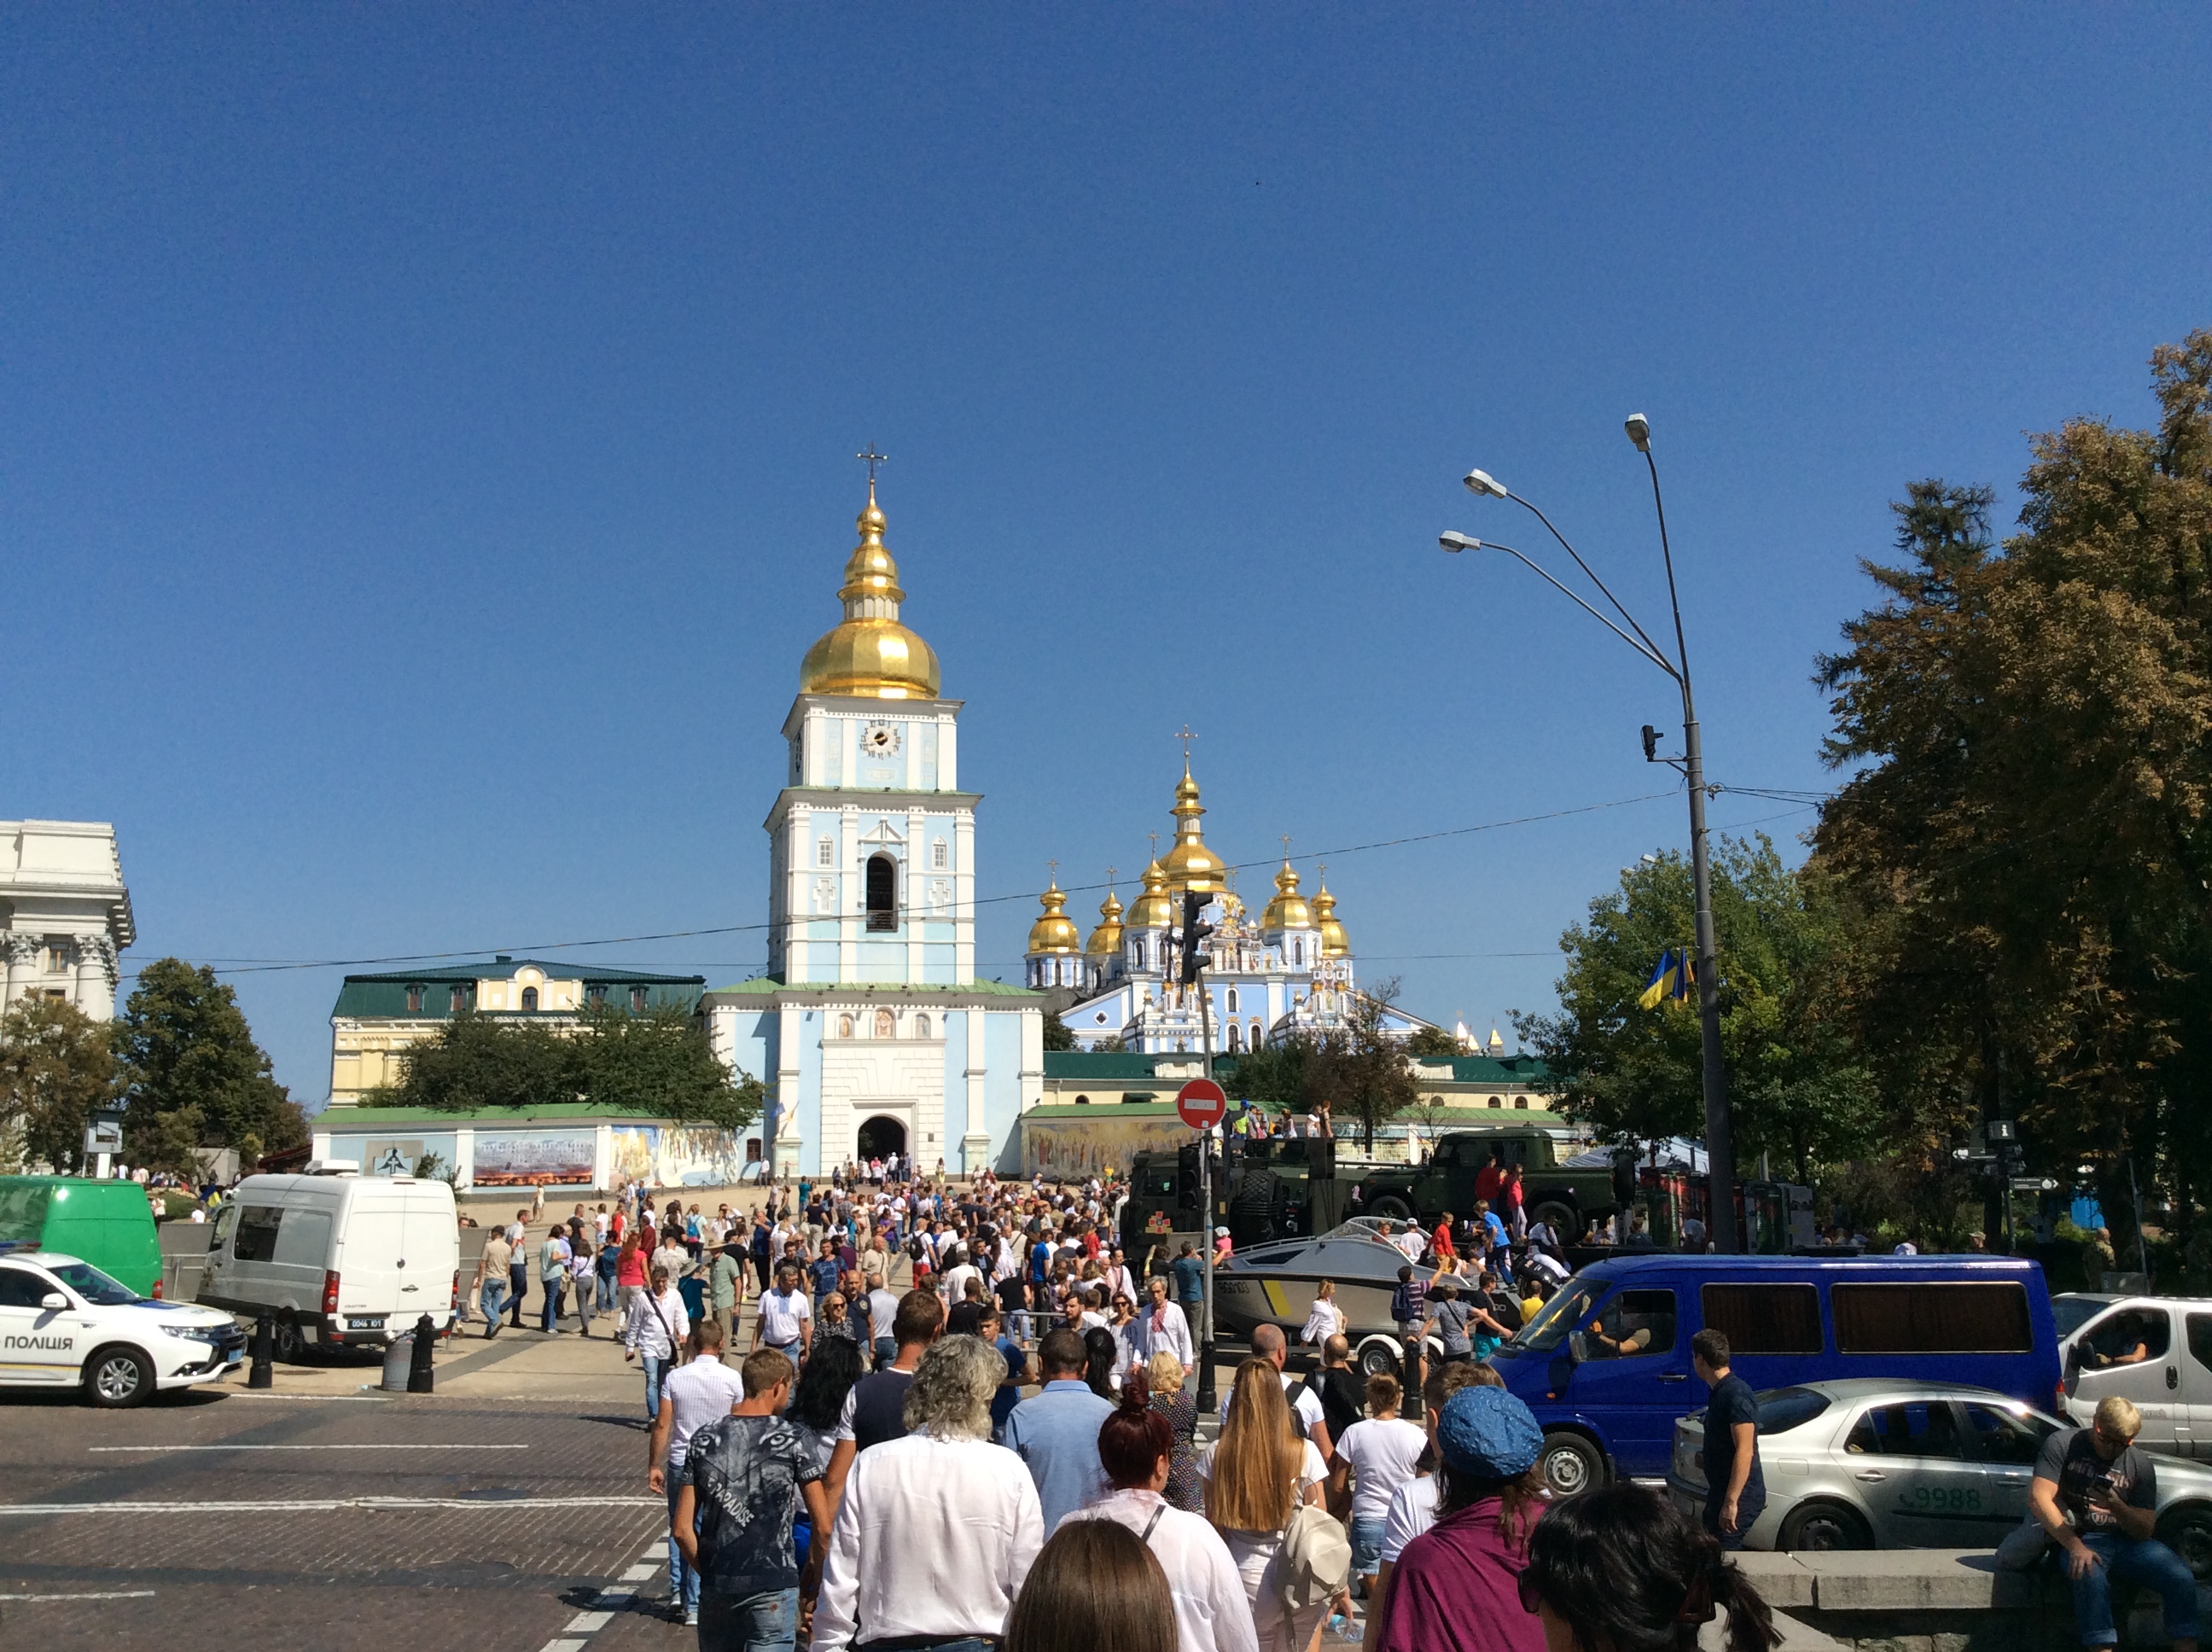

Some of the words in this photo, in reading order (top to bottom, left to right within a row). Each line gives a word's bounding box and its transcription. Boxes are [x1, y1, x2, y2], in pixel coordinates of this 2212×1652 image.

[4, 1335, 73, 1350] ПОЛІЦІЯ
[710, 1482, 755, 1527] PARADISE
[1915, 1486, 1982, 1510] 9988
